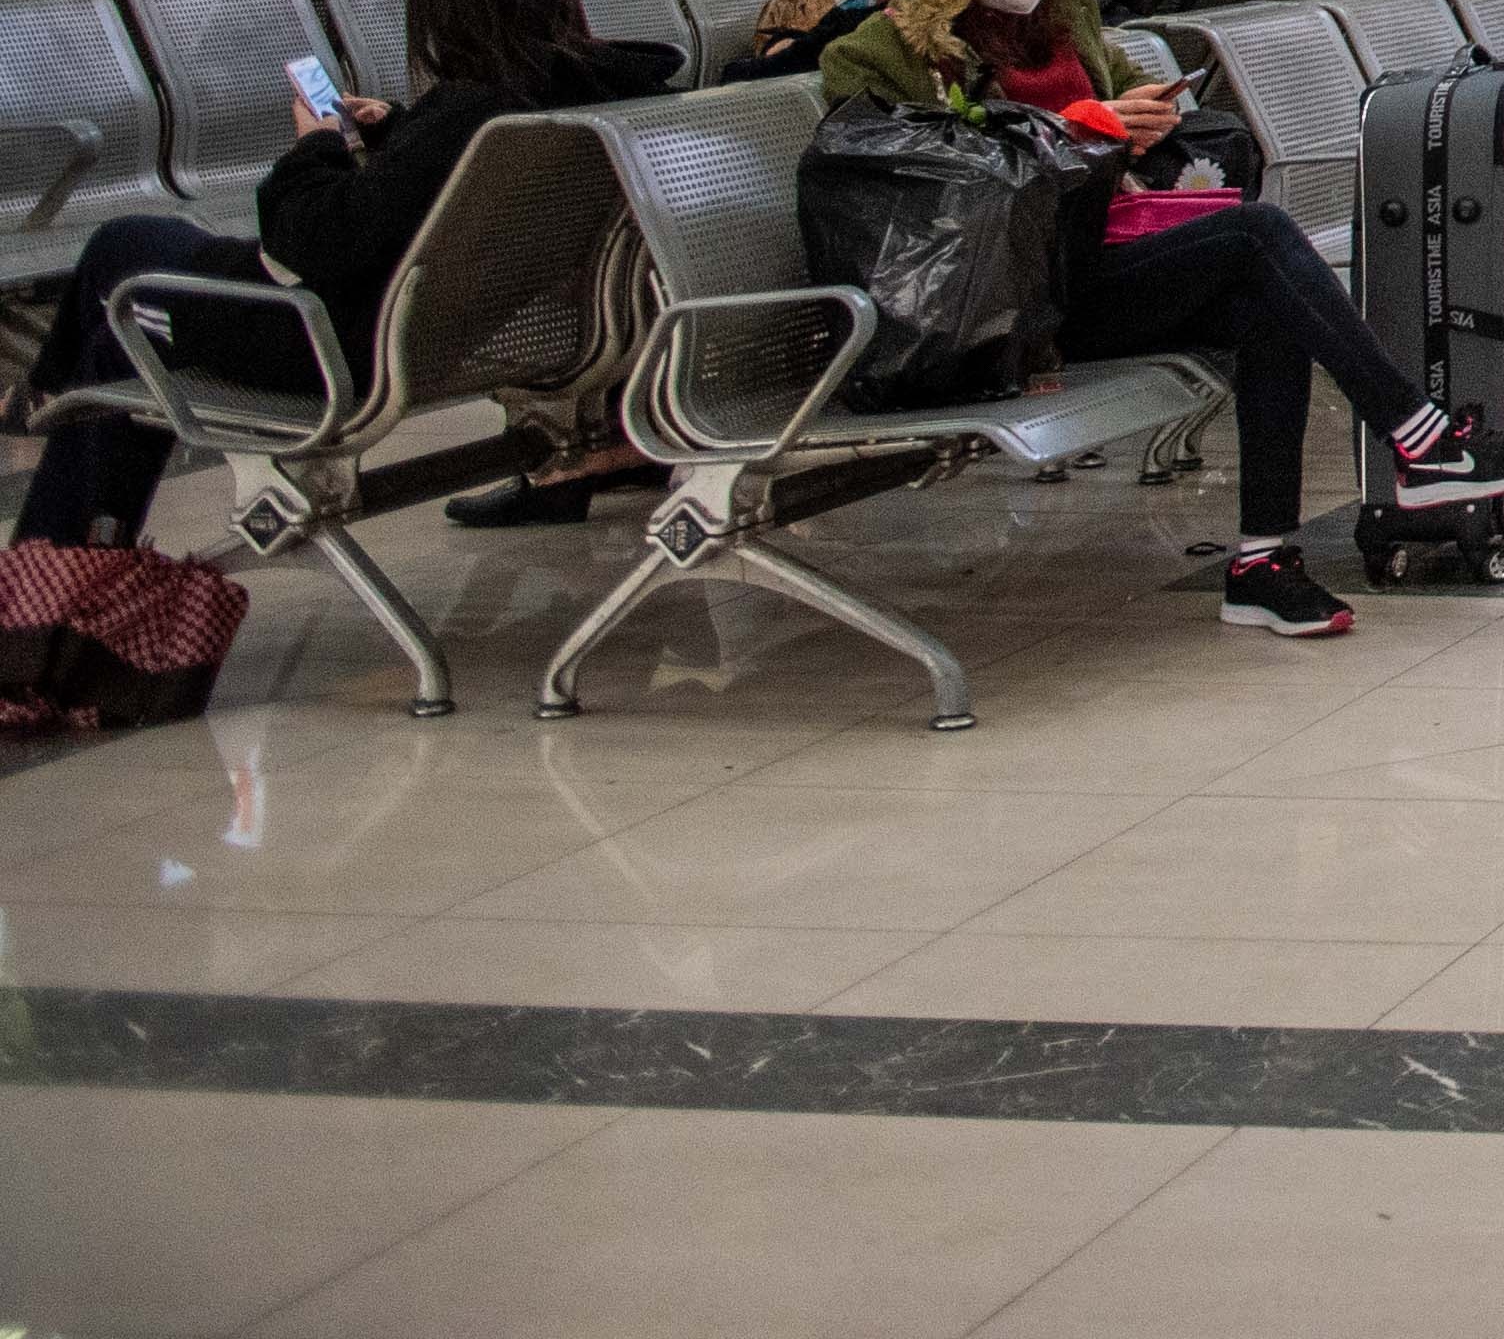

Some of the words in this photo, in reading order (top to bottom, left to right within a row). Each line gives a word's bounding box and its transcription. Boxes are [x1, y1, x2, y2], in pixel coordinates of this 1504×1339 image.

[1427, 184, 1443, 225] ASIA
[1428, 232, 1443, 326] TOURISTME
[1448, 309, 1476, 329] SIA
[1429, 359, 1445, 402] ASIA
